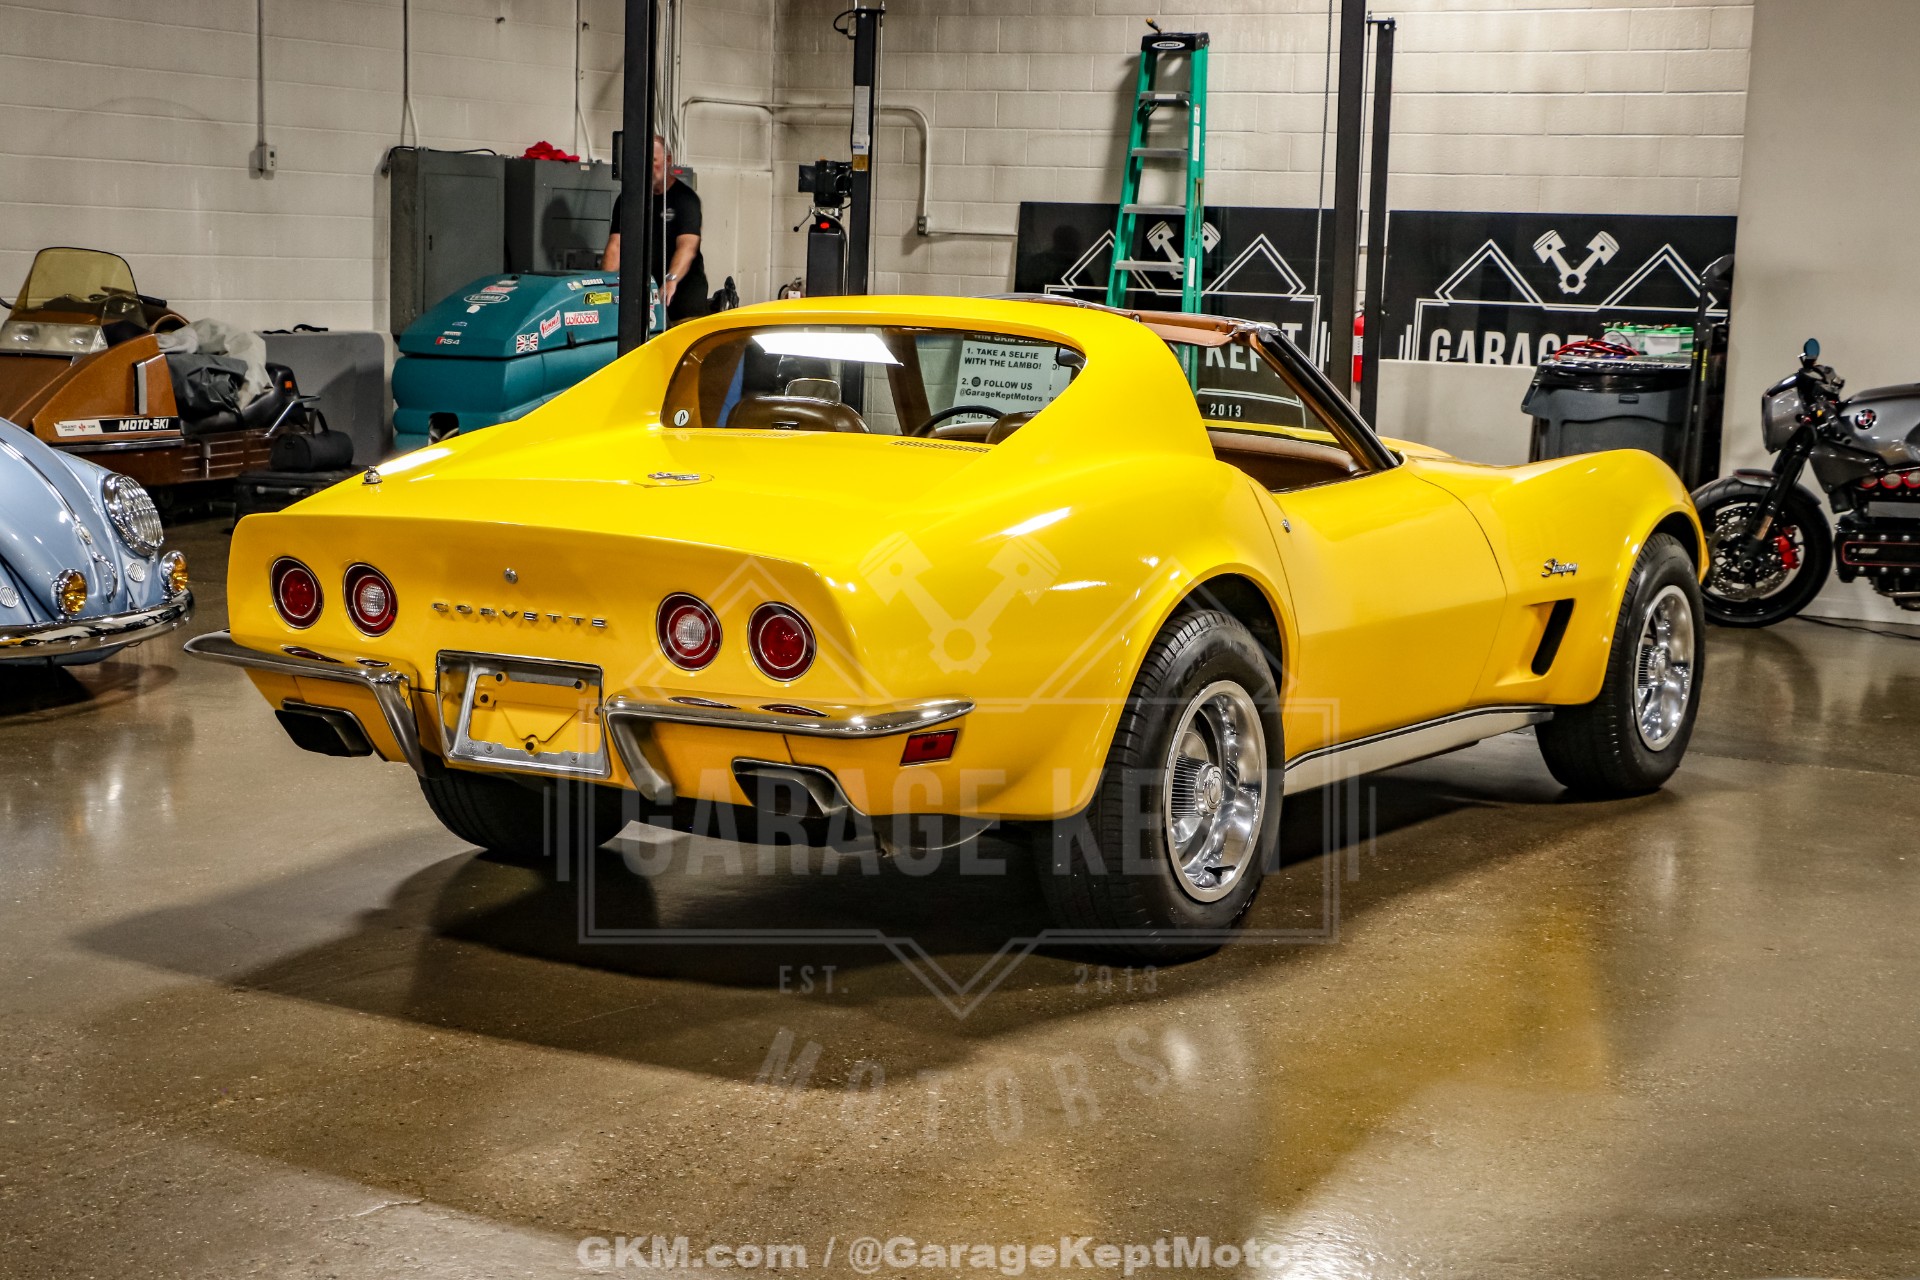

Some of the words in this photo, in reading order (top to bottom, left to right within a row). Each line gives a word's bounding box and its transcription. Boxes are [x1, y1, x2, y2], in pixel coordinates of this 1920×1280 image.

[1429, 328, 1588, 365] GARAG
[976, 348, 998, 356] TAKE
[1008, 350, 1040, 360] SELFIE
[964, 357, 987, 366] WITH
[989, 358, 1006, 368] THE
[1008, 360, 1042, 370] LAMBO!
[984, 380, 1018, 390] FOLLOW
[1020, 382, 1033, 390] US
[960, 388, 1043, 402] @GarageKeptMotors
[1210, 404, 1242, 418] 2013
[118, 418, 169, 430] MOTO-SKI
[431, 602, 608, 628] CORVETTE
